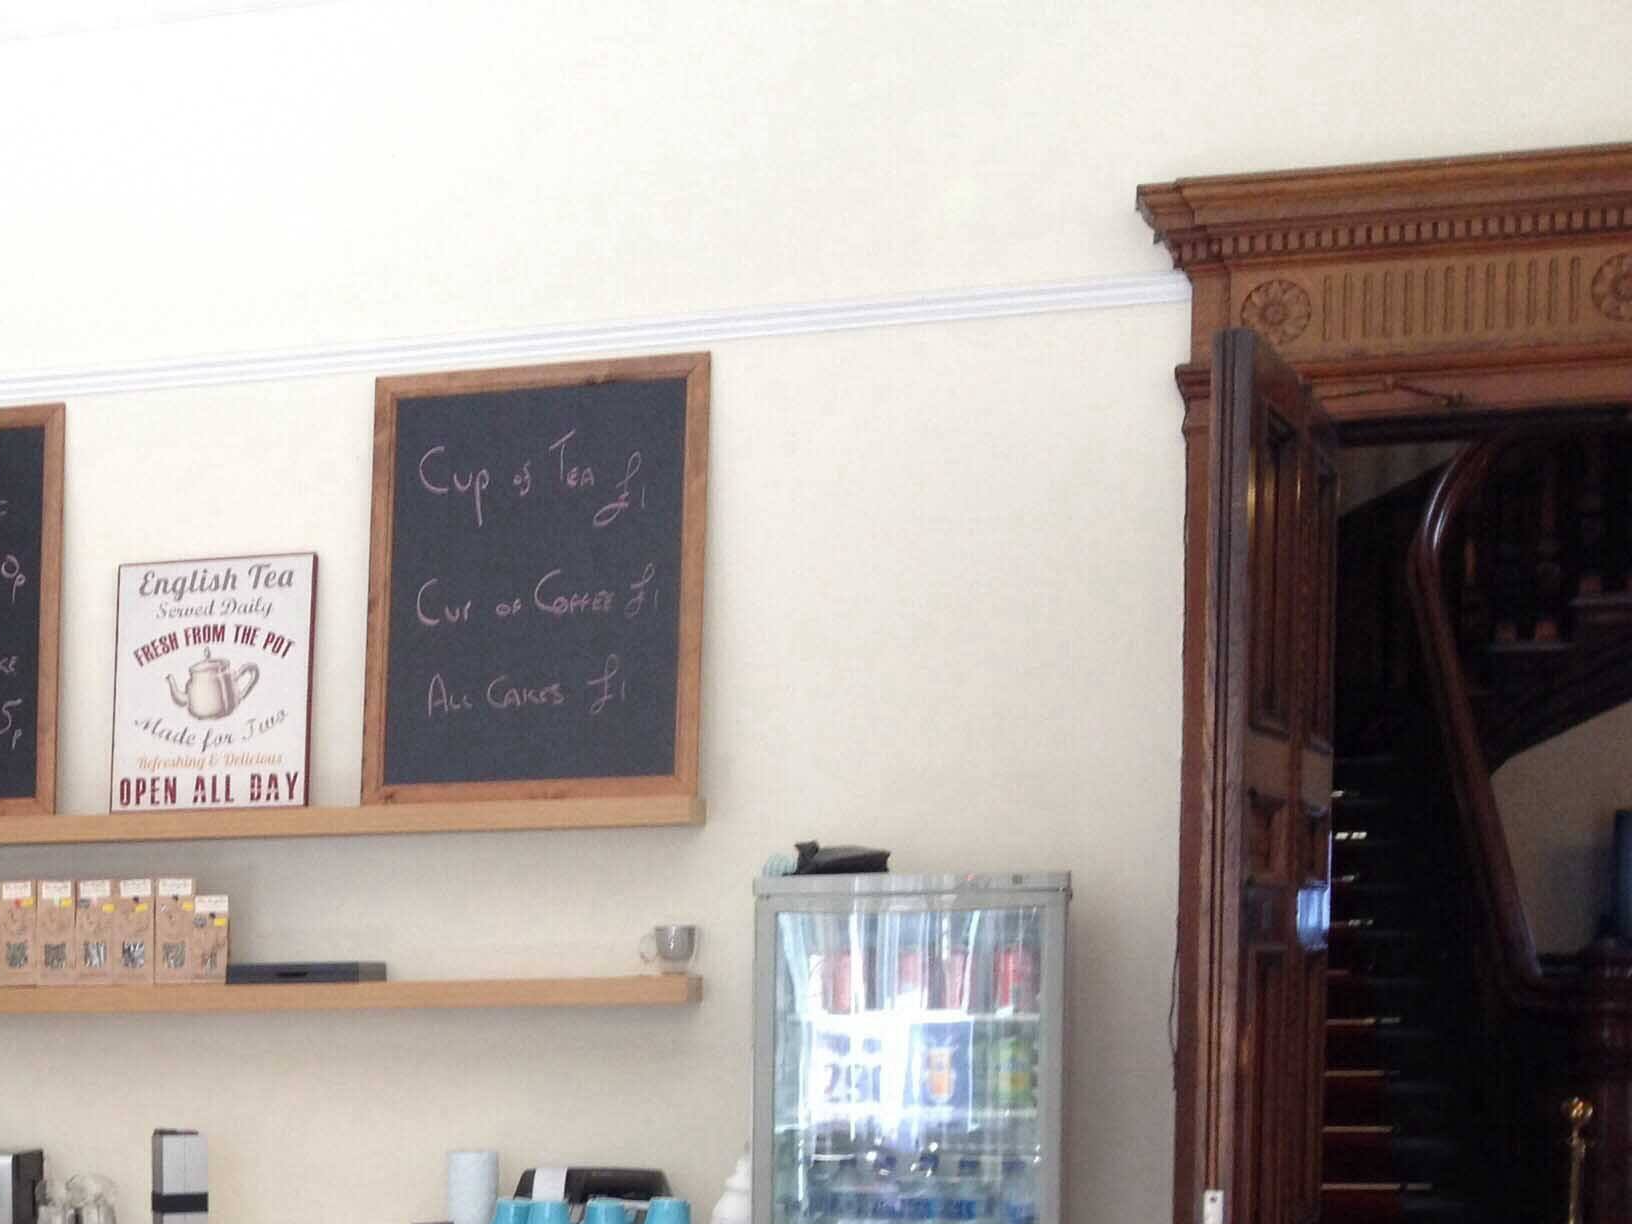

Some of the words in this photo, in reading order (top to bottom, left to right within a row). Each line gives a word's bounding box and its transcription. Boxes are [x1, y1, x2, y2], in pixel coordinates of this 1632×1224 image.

[139, 568, 238, 600] English
[248, 563, 294, 590] Tea
[156, 603, 215, 619] Served
[220, 597, 273, 619] Daily
[133, 632, 180, 667] FRESH
[184, 624, 226, 647] FROM
[233, 624, 261, 648] THE
[263, 632, 296, 659] POT
[134, 717, 196, 746] Made
[202, 728, 233, 752] for
[119, 777, 177, 806] OPEN
[193, 774, 235, 803] ALL
[250, 771, 299, 802] DAY
